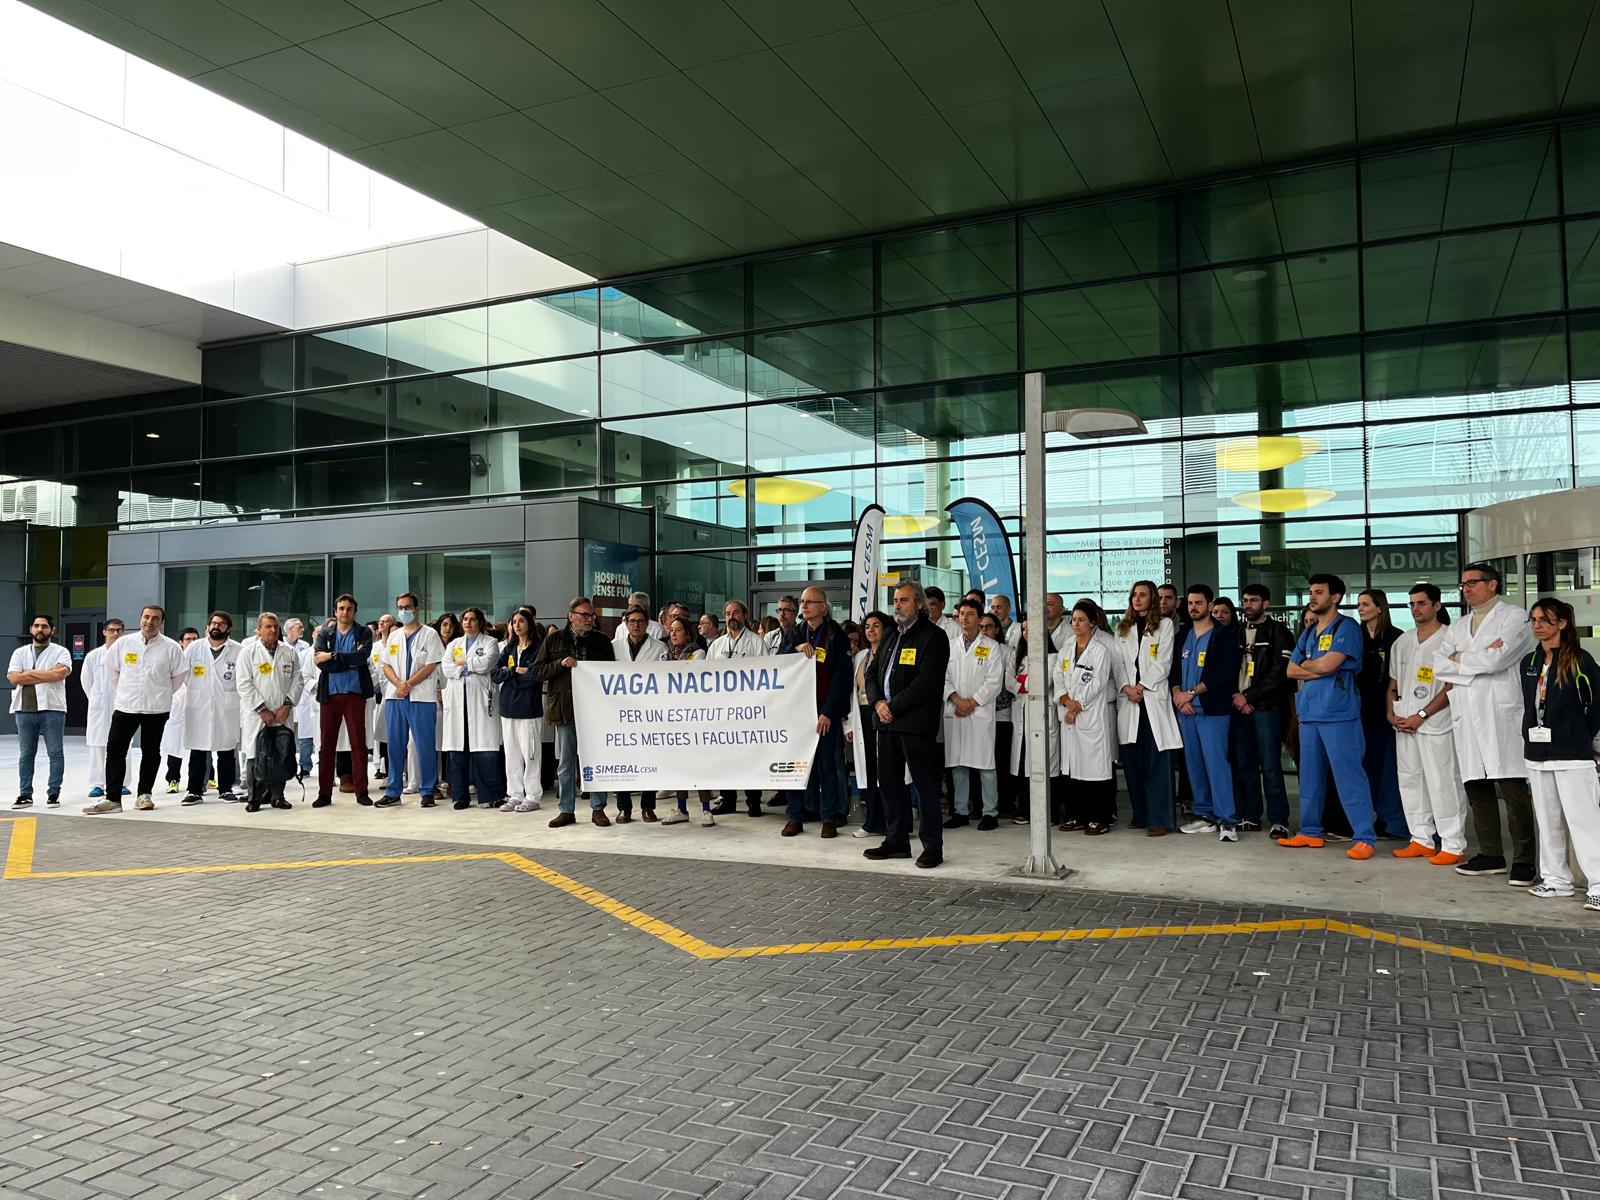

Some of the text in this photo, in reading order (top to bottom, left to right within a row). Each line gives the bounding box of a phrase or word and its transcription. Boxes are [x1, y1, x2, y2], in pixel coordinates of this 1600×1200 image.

[863, 523, 874, 575] CESM
[1136, 537, 1170, 546] scienca
[1371, 550, 1457, 570] ADMIS
[594, 571, 631, 586] HOSPITAL
[592, 584, 616, 597] SENSE
[599, 668, 785, 695] VAGA NACIONAL
[619, 705, 766, 722] PER UN ESTATUT PROPI
[606, 729, 789, 746] PELS METGES I FACULTATIUS
[595, 764, 658, 774] SIMEBAL CESM
